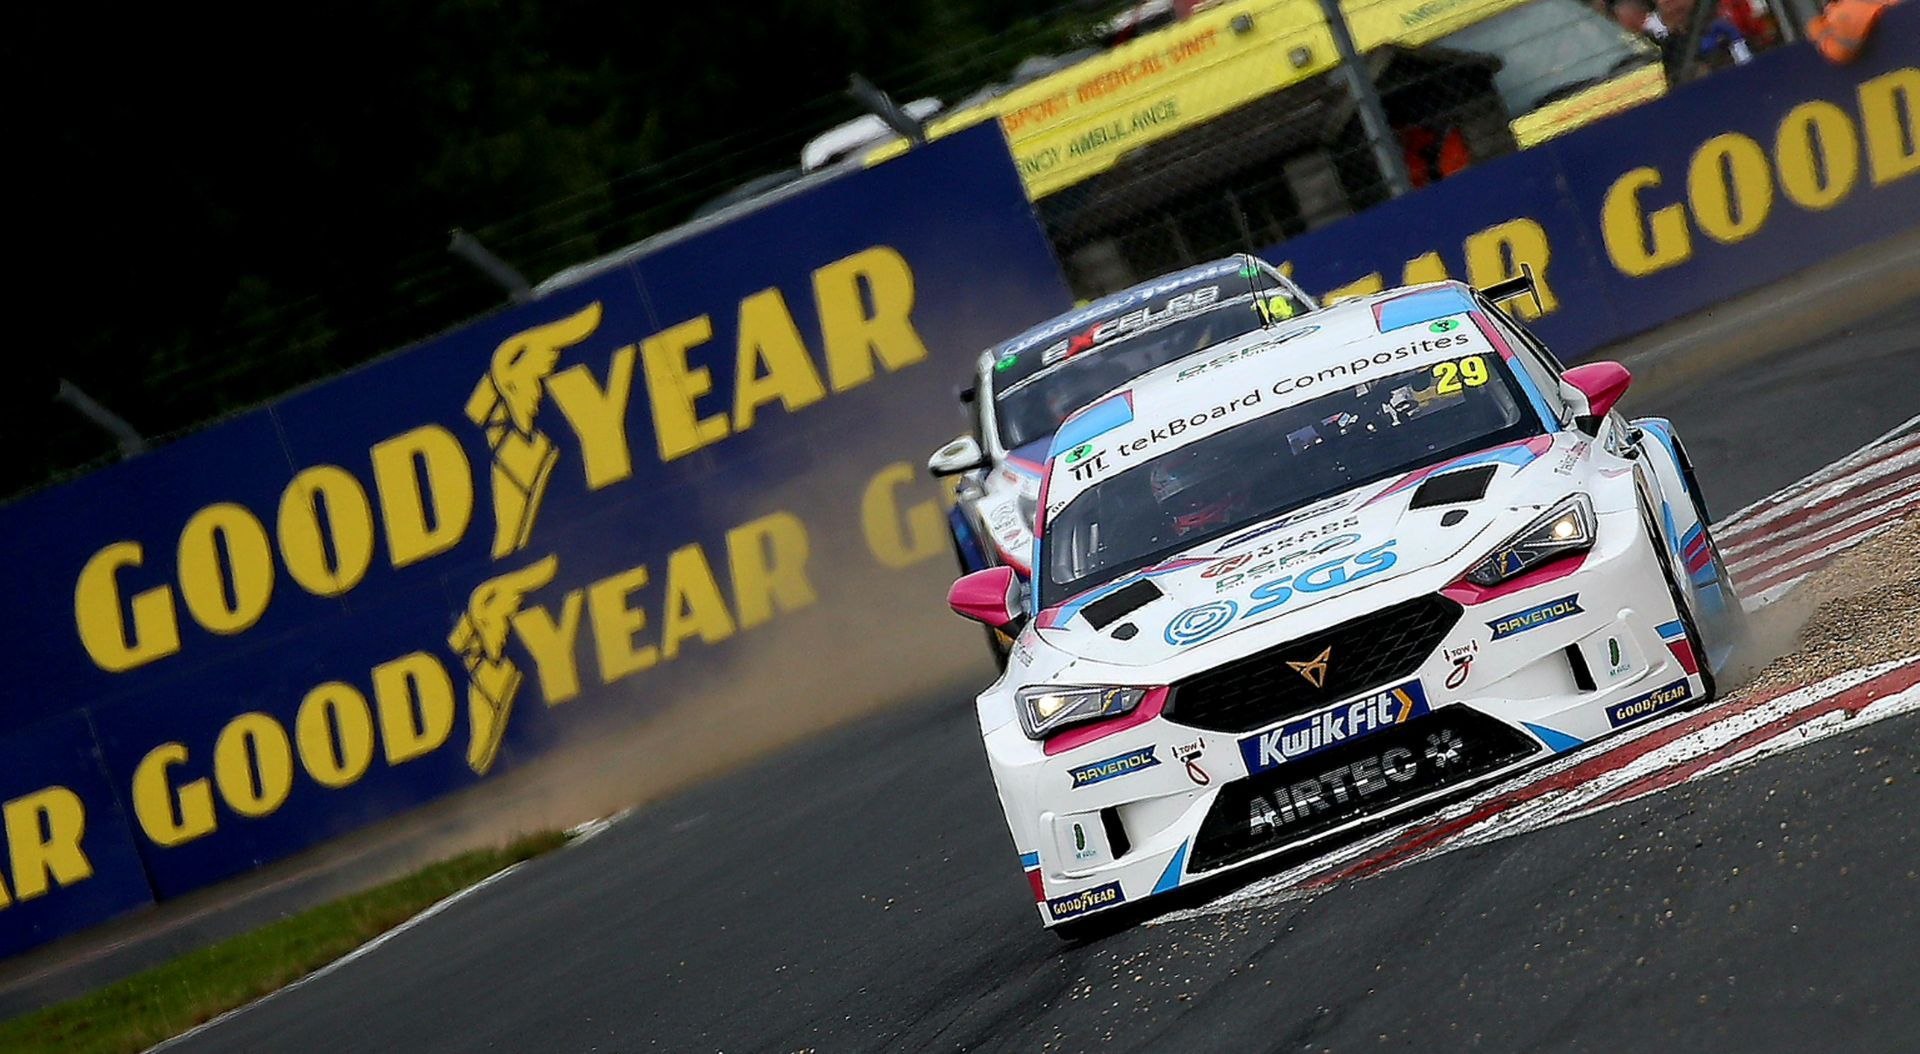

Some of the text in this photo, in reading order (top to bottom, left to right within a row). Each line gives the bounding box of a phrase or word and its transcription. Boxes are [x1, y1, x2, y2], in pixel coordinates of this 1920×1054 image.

[1432, 355, 1489, 395] 29
[1118, 389, 1261, 457] tekBoard
[1273, 333, 1469, 394] Composites
[1242, 538, 1398, 620] SGS
[1495, 600, 1576, 635] RAVENOL
[1451, 645, 1470, 658] TOW
[1179, 742, 1198, 754] TOW
[1076, 752, 1151, 782] RAVENOL
[1248, 746, 1417, 836] AIRTEC
